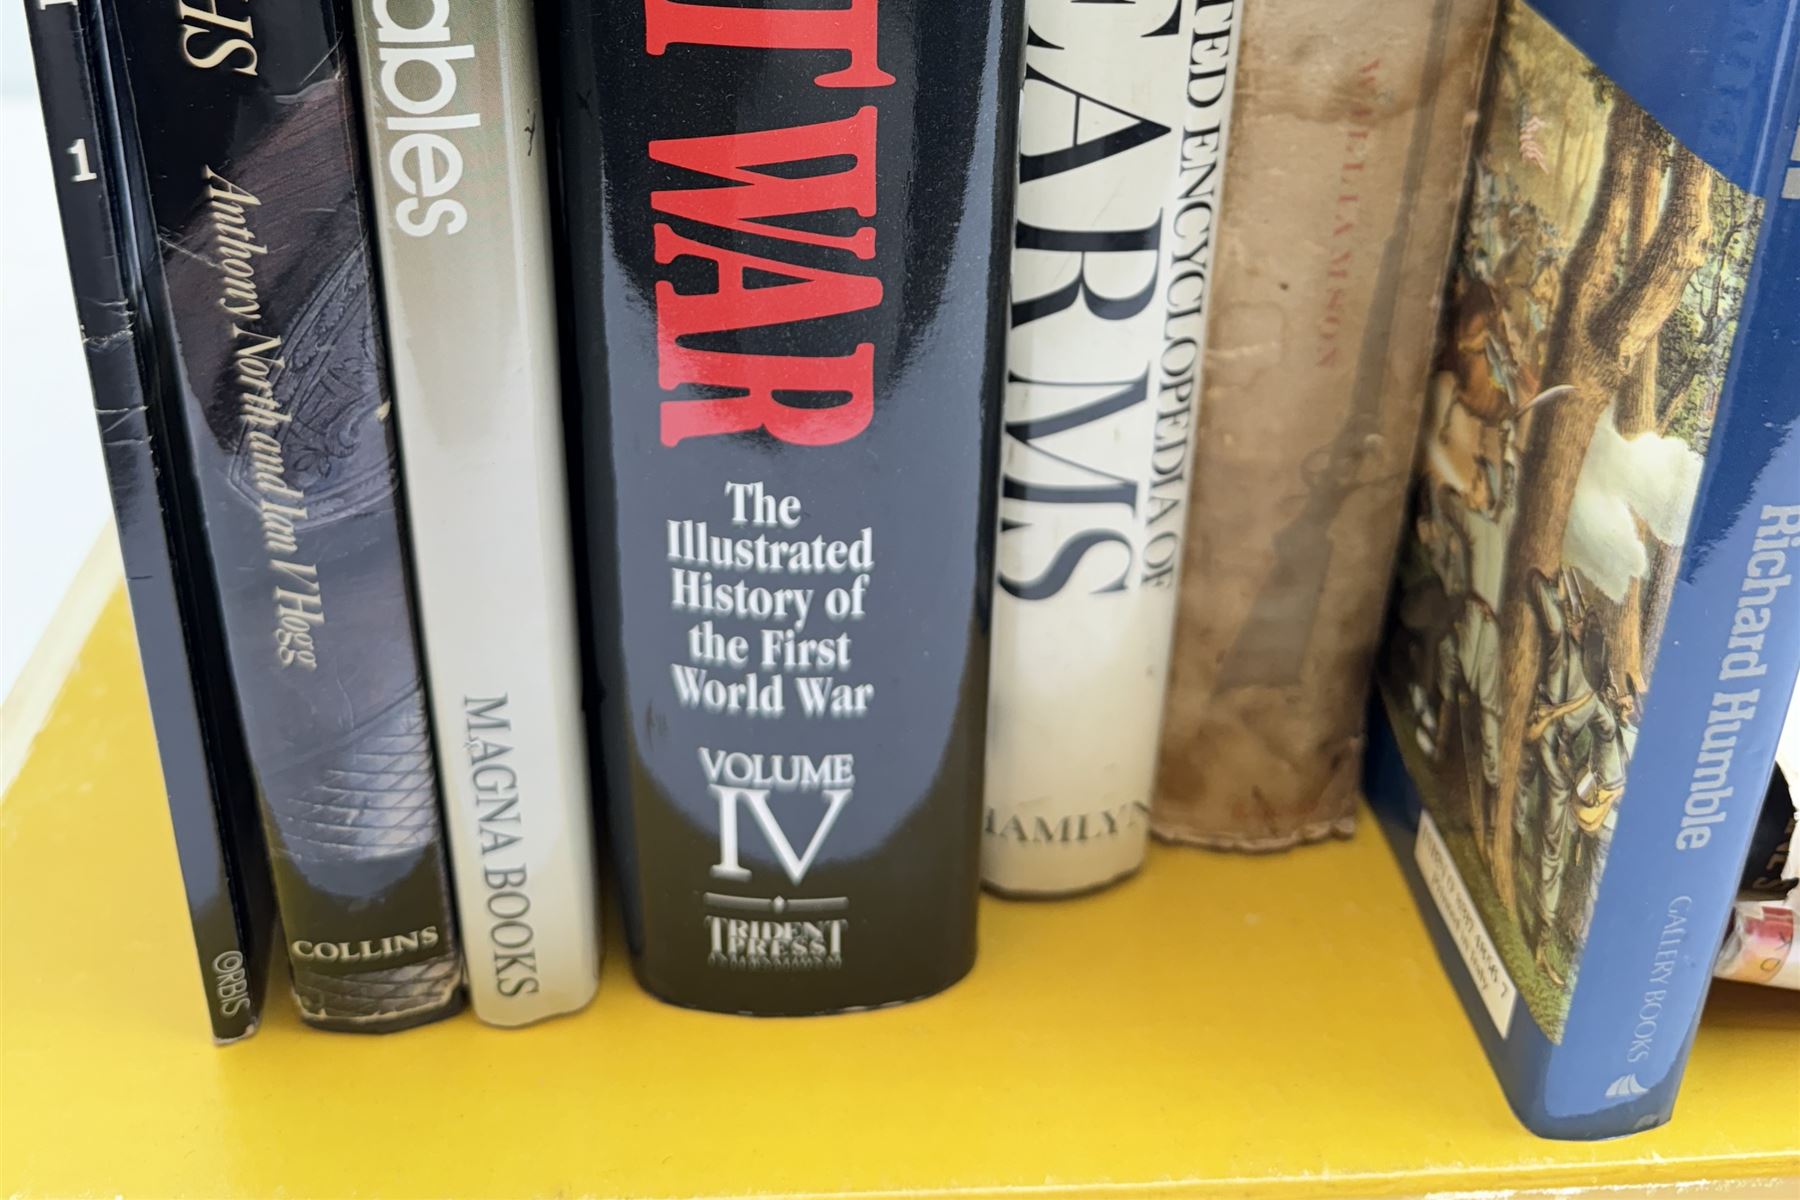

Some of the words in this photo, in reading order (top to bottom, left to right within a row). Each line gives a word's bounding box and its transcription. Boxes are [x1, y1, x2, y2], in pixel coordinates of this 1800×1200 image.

[66, 138, 98, 183] 1
[203, 165, 268, 319] Anthony
[648, 105, 884, 448] WAR
[1146, 119, 1222, 525] ENCYCLOPEDIA
[232, 323, 292, 427] North
[249, 430, 304, 498] and
[260, 499, 308, 552] Ian
[725, 481, 801, 527] The
[269, 559, 320, 592] V
[667, 519, 874, 572] Illustrated
[1141, 531, 1178, 588] OF
[671, 568, 814, 628] History
[826, 574, 870, 618] of
[1719, 502, 1800, 681] Richard
[274, 585, 325, 671] Hogg
[689, 622, 748, 664] the
[761, 629, 851, 671] First
[671, 663, 784, 714] World
[795, 676, 874, 714] War
[465, 694, 527, 856] MAGNA
[698, 746, 855, 786] VOLUME
[1675, 688, 1761, 852] Humble
[707, 784, 854, 884] IV
[292, 927, 439, 962] COLLINS
[484, 863, 540, 999] BOOKS
[704, 915, 849, 955] TRIDENT
[728, 937, 828, 960] PRESS
[1645, 894, 1693, 990] GALLERY
[211, 950, 251, 1017] ORBIS
[1628, 988, 1668, 1065] BOOKS
